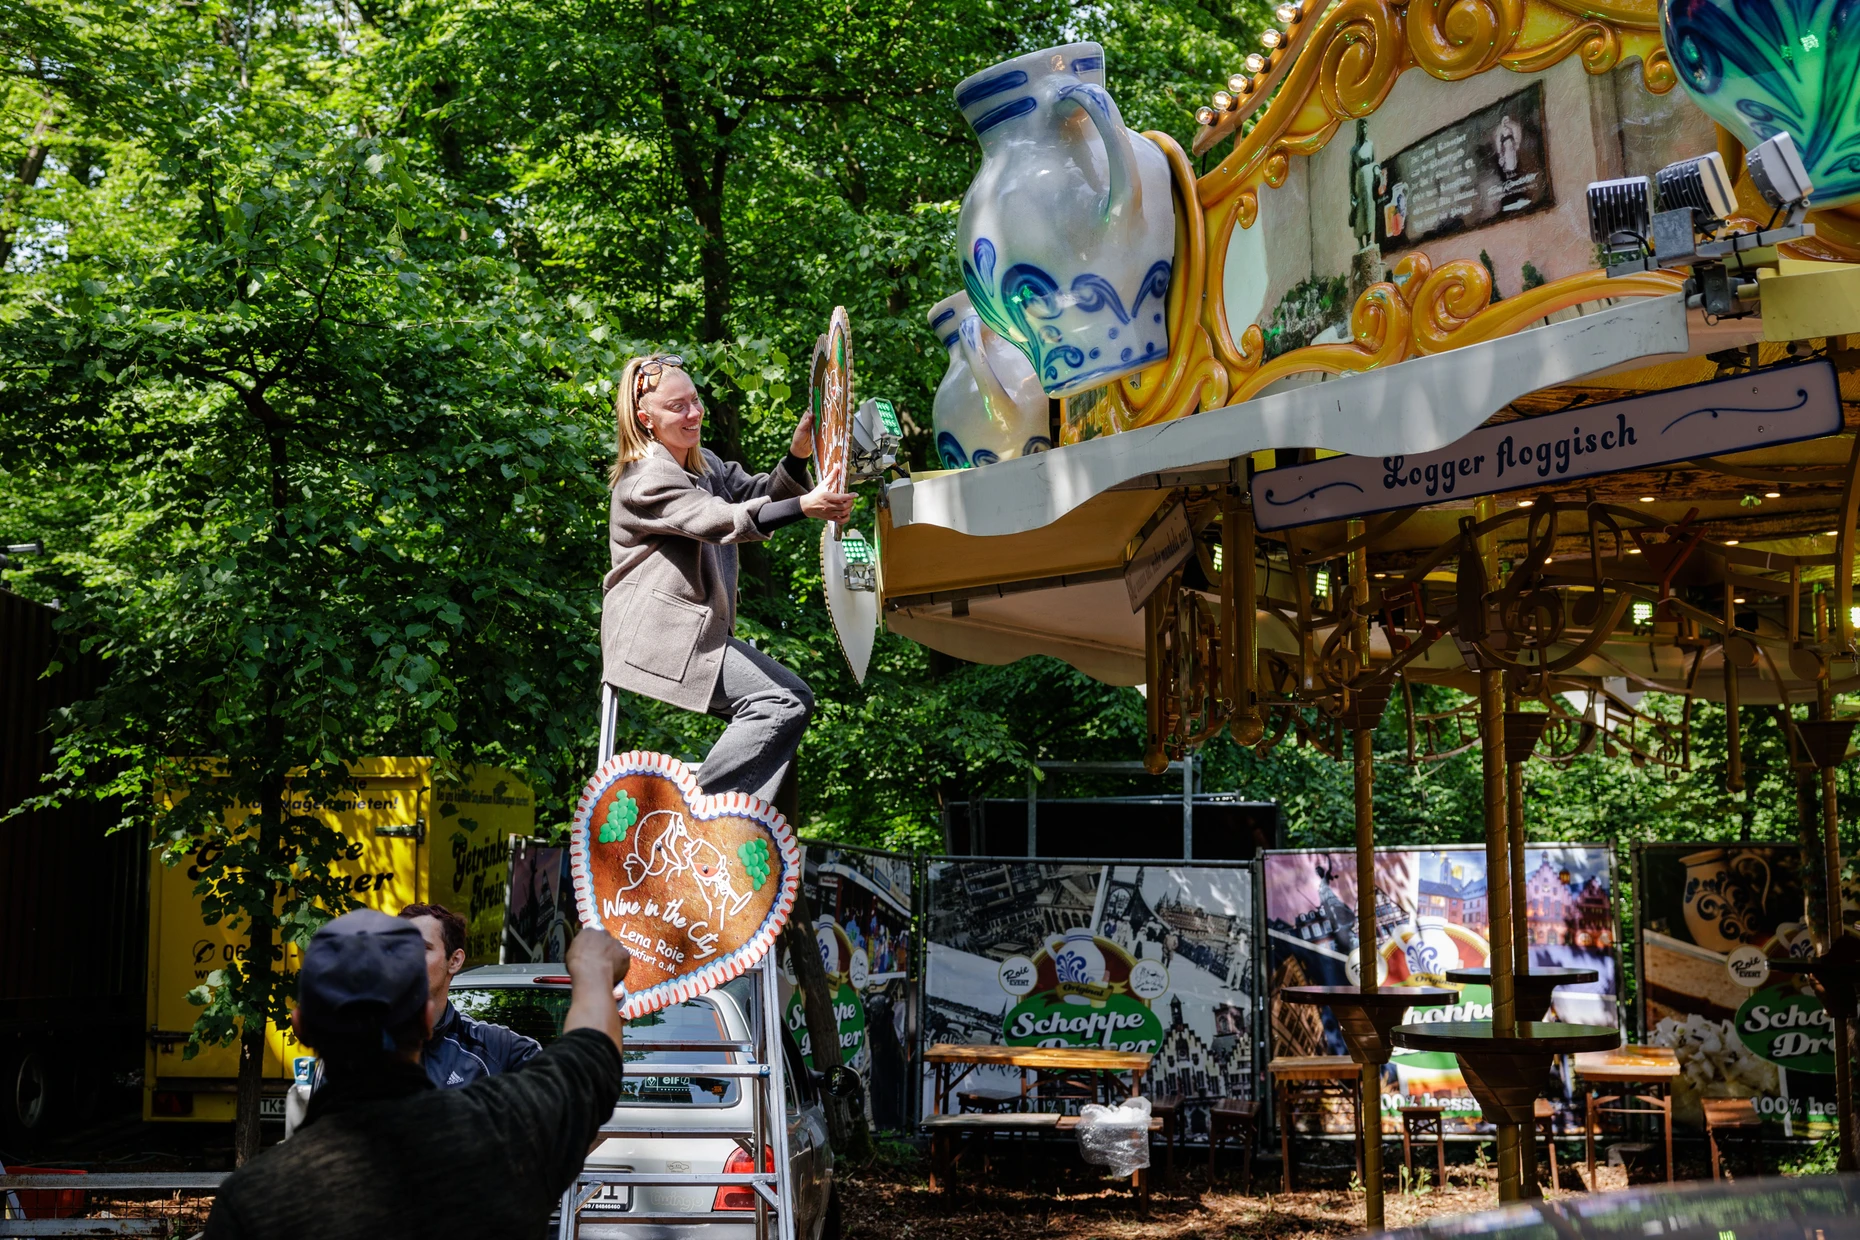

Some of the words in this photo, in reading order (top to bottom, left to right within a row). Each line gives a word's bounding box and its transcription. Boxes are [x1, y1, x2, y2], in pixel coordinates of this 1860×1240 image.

[1383, 455, 1485, 496] Logger
[603, 898, 641, 919] Wine
[644, 898, 660, 917] in
[662, 898, 687, 929] the
[687, 921, 719, 960] City
[619, 923, 651, 949] Lena
[655, 939, 685, 963] Roie
[1731, 956, 1761, 973] Roie
[1003, 966, 1030, 982] Roie
[1739, 970, 1761, 978] EVENT
[1062, 984, 1106, 998] Original
[1010, 1011, 1145, 1042] Schoppe
[662, 1076, 680, 1085] elf
[1749, 1096, 1802, 1115] 100%
